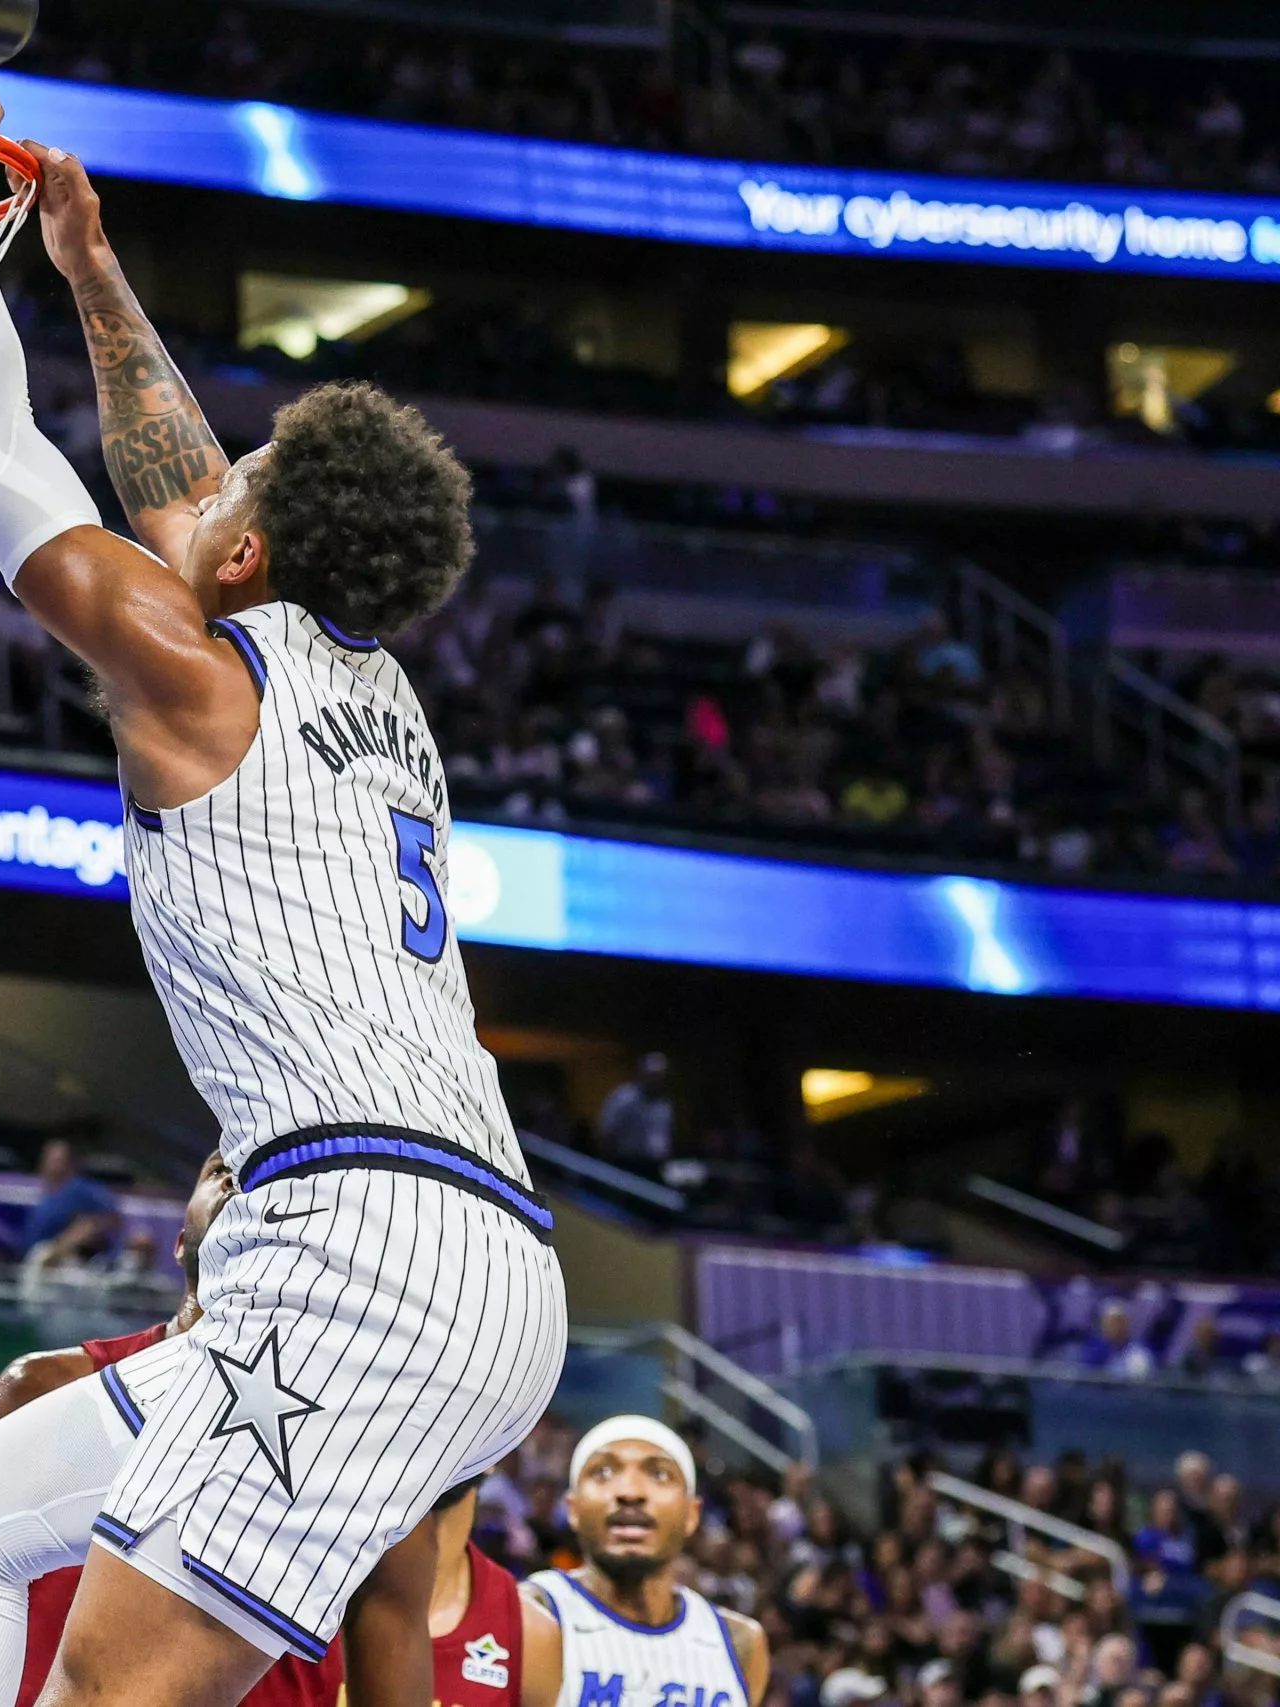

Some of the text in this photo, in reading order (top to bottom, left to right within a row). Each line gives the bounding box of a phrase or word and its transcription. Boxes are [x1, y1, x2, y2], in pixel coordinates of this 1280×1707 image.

[740, 180, 843, 236] Your
[844, 191, 1122, 263] cybersecurity
[1124, 206, 1247, 263] home
[298, 702, 443, 815] BANCHERO
[387, 804, 448, 965] 5
